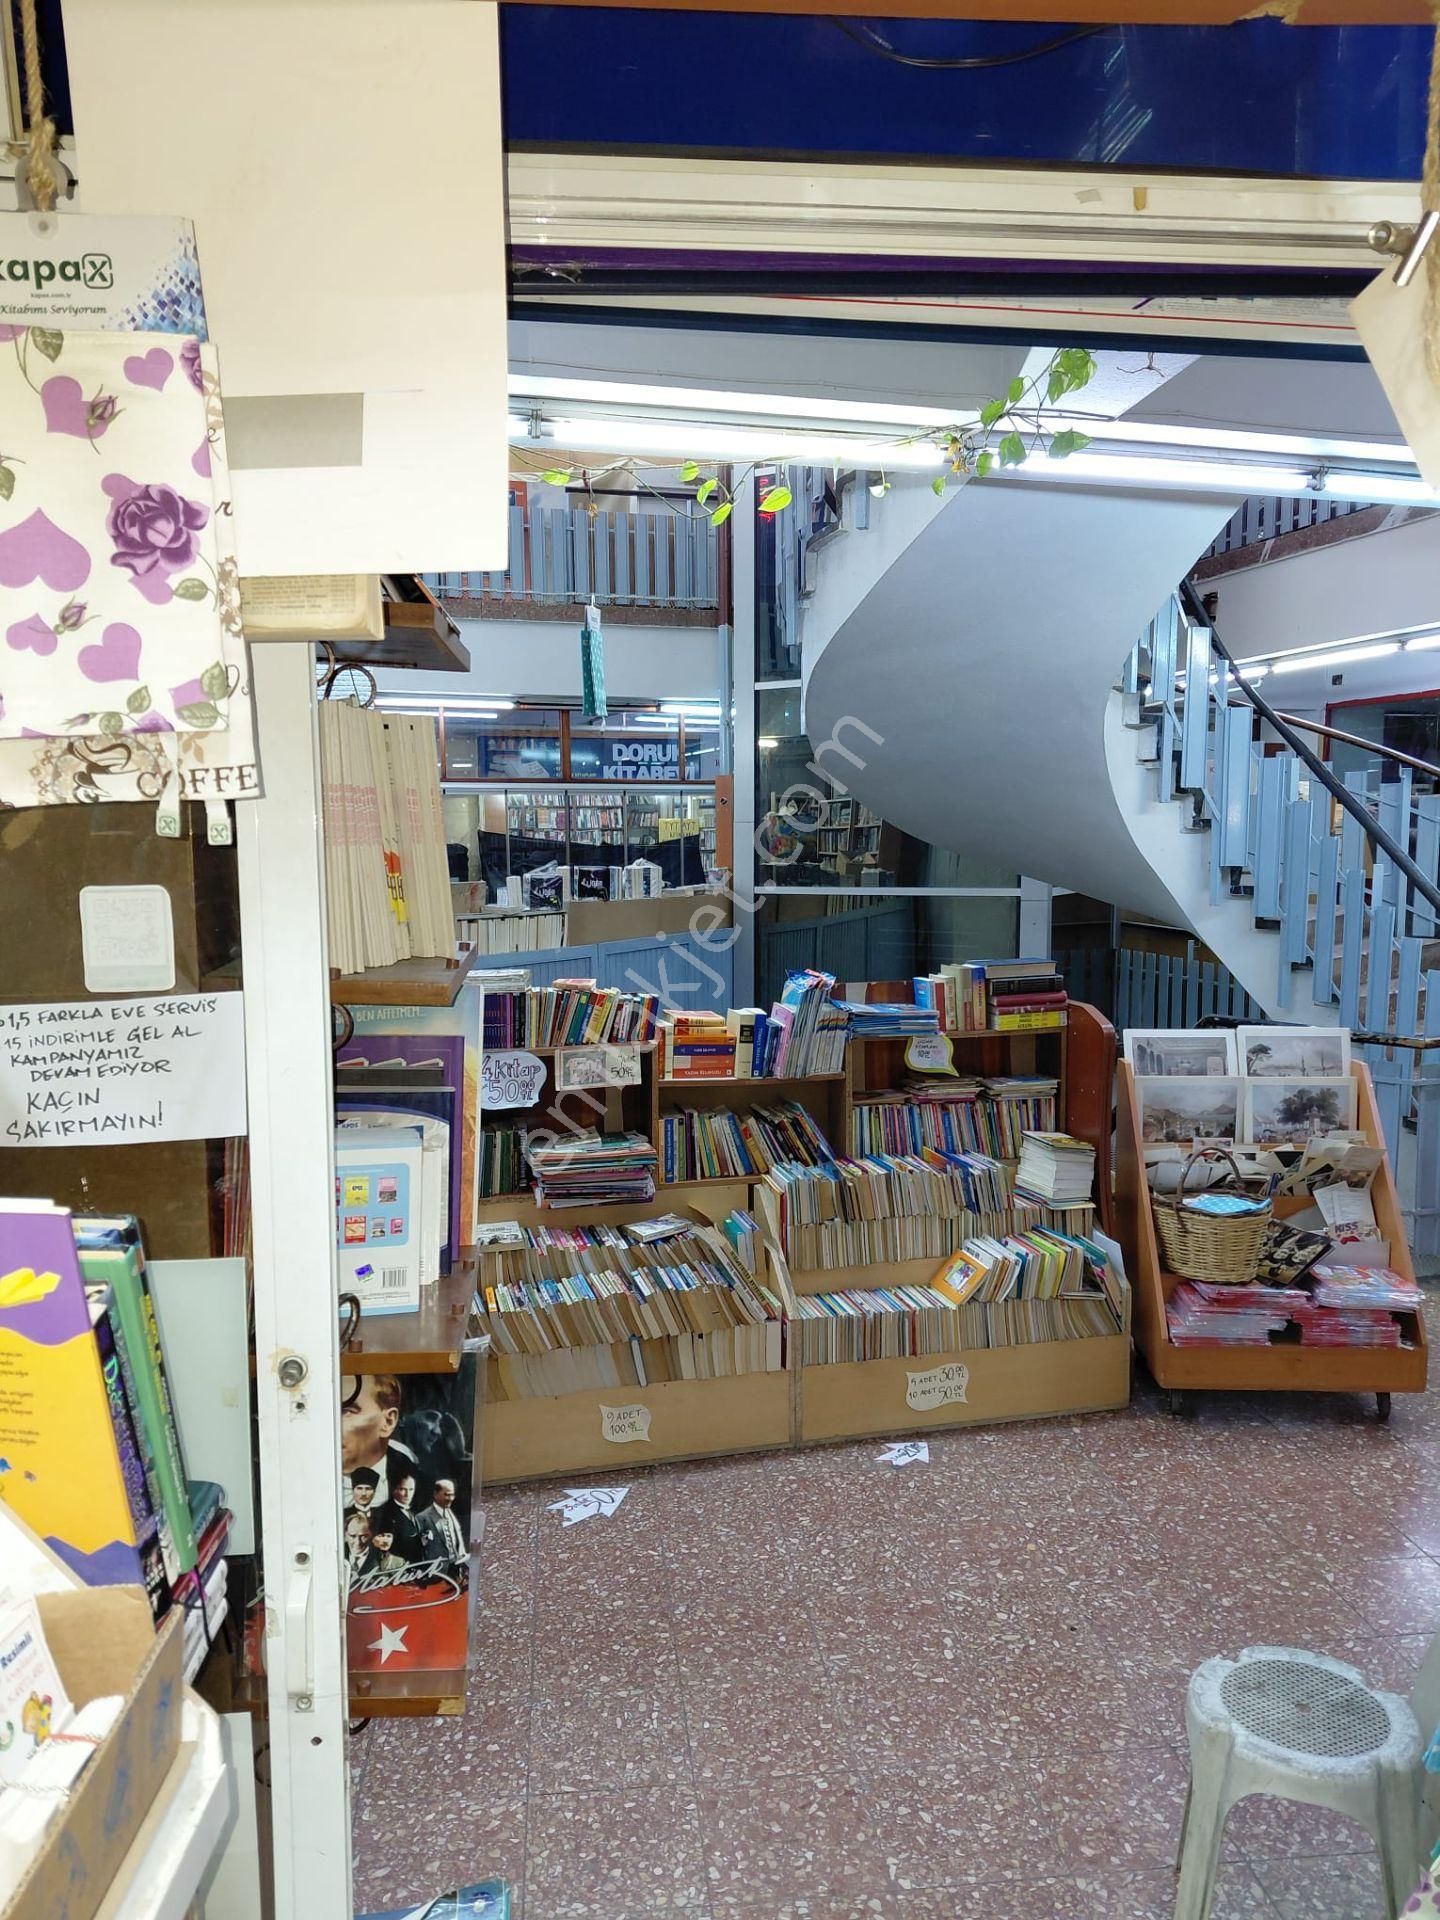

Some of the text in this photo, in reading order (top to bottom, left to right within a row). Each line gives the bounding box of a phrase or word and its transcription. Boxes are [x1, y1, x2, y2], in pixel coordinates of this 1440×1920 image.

[49, 304, 107, 318] Seviyorum
[38, 1007, 103, 1025] FARKLA
[111, 1005, 145, 1021] EVE
[127, 1025, 163, 1044] GEL
[171, 1025, 203, 1039] AL
[11, 1046, 144, 1068] KAMPANYAMIZ
[31, 1066, 91, 1083] DEVAM
[27, 1087, 100, 1114] KAÇIN
